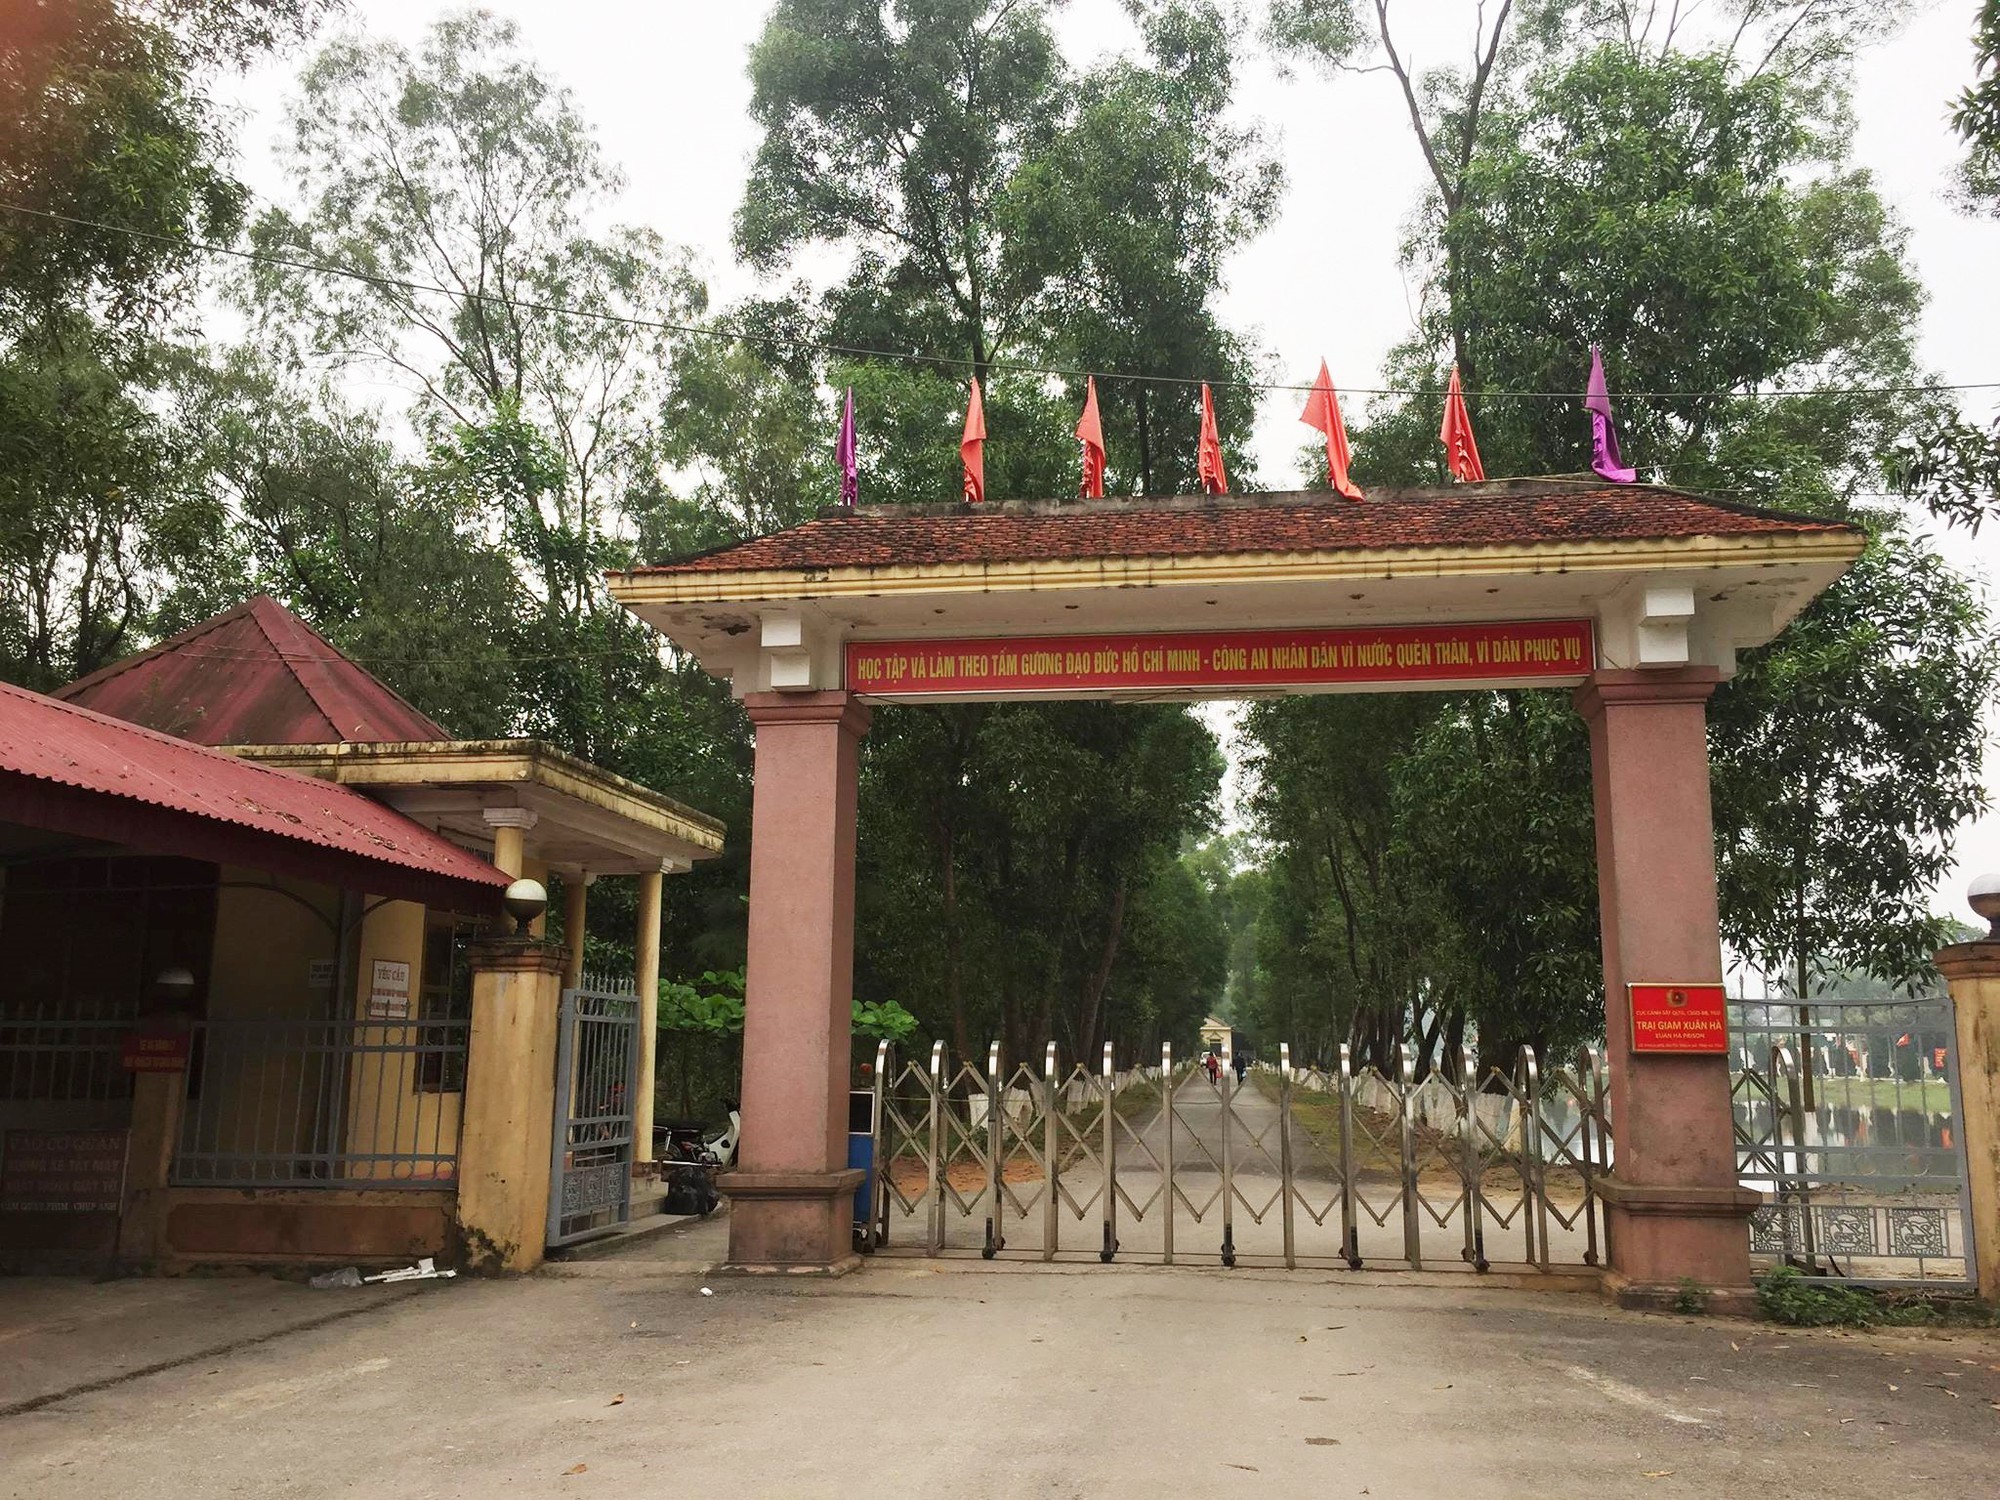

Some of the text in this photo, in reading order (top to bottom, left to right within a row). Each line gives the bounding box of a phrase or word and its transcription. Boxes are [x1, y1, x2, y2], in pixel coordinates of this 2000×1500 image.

[858, 657, 881, 684] HỌC
[885, 653, 907, 684] TẬP
[911, 652, 926, 679] VÀ
[929, 651, 955, 678] LÀM
[958, 655, 987, 677] THEO
[991, 647, 1017, 676] TẤM
[1021, 651, 1062, 676] GƯƠNG
[1066, 652, 1090, 679] ĐẠO
[1094, 645, 1118, 674] ĐỨC
[1122, 643, 1139, 673] HỒ
[1143, 645, 1163, 672] CHÍ
[1167, 649, 1200, 672] MINH
[1213, 644, 1247, 671] CÔNG
[1251, 648, 1268, 670] AN
[1272, 642, 1307, 670] NHÂN
[1311, 641, 1338, 669] DÂN
[1341, 640, 1354, 668] VÌ
[1358, 637, 1393, 667] NƯỚC
[1396, 640, 1431, 668] QUÊN
[1434, 637, 1473, 666] THÂN,
[1476, 636, 1489, 664] VÌ
[1493, 635, 1520, 663] DÂN
[1524, 639, 1560, 667] PHỤC
[1563, 637, 1581, 665] VỤ
[1636, 1018, 1722, 1032] TRẠI GIAM XUÂN HÀ
